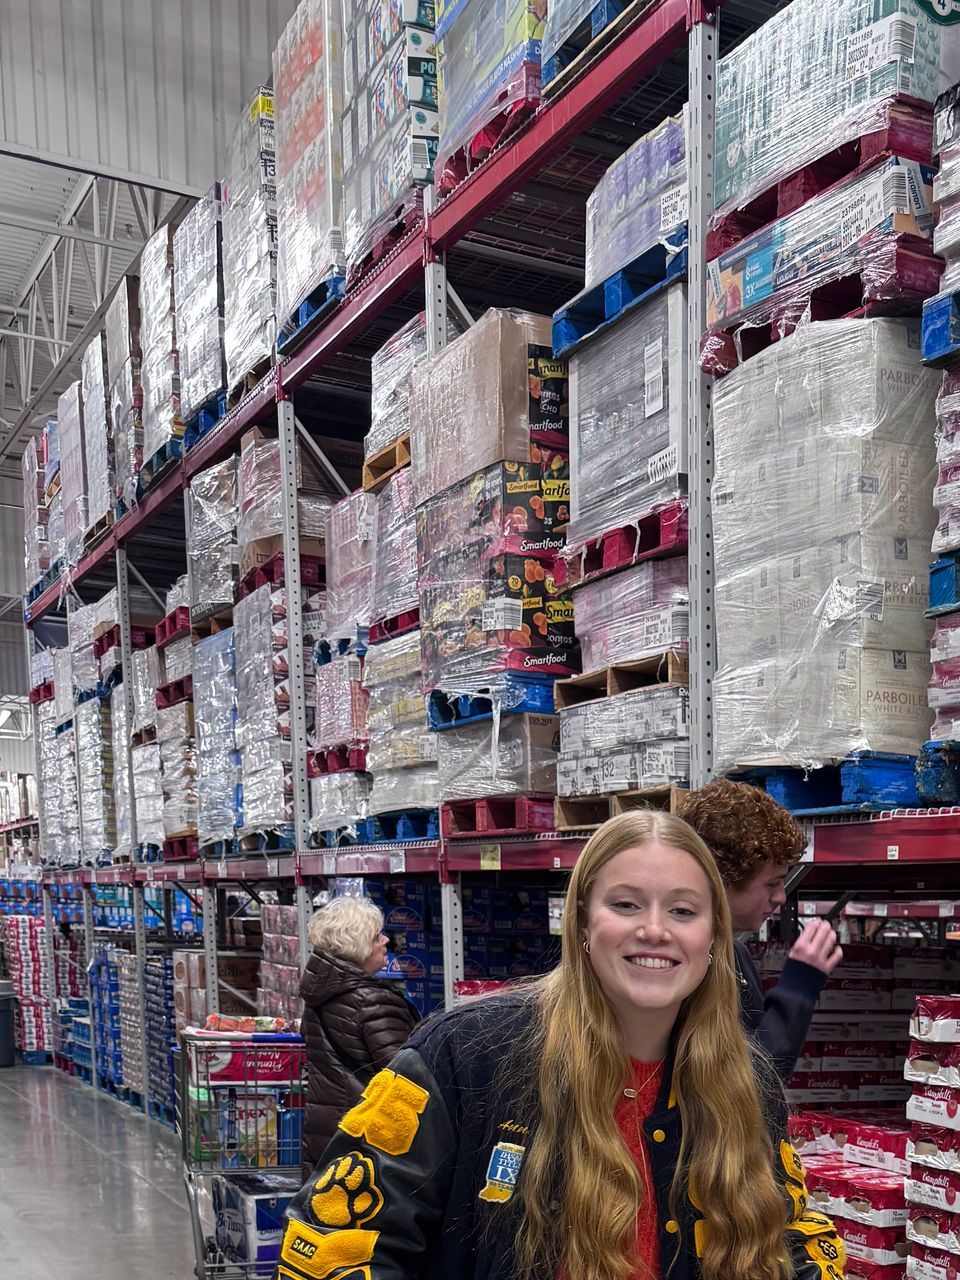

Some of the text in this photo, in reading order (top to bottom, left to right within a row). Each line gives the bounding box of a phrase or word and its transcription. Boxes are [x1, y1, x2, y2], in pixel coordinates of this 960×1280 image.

[520, 537, 564, 551] Smartfood
[524, 653, 567, 667] Smartfood
[924, 1086, 951, 1101] Campbell's
[857, 1136, 880, 1150] Campbell's
[493, 1165, 519, 1184] IX
[922, 1170, 950, 1188] Campbell's
[843, 1228, 867, 1246] Campbell's
[293, 1239, 316, 1257] SAAC
[924, 1250, 950, 1268] Campbell's
